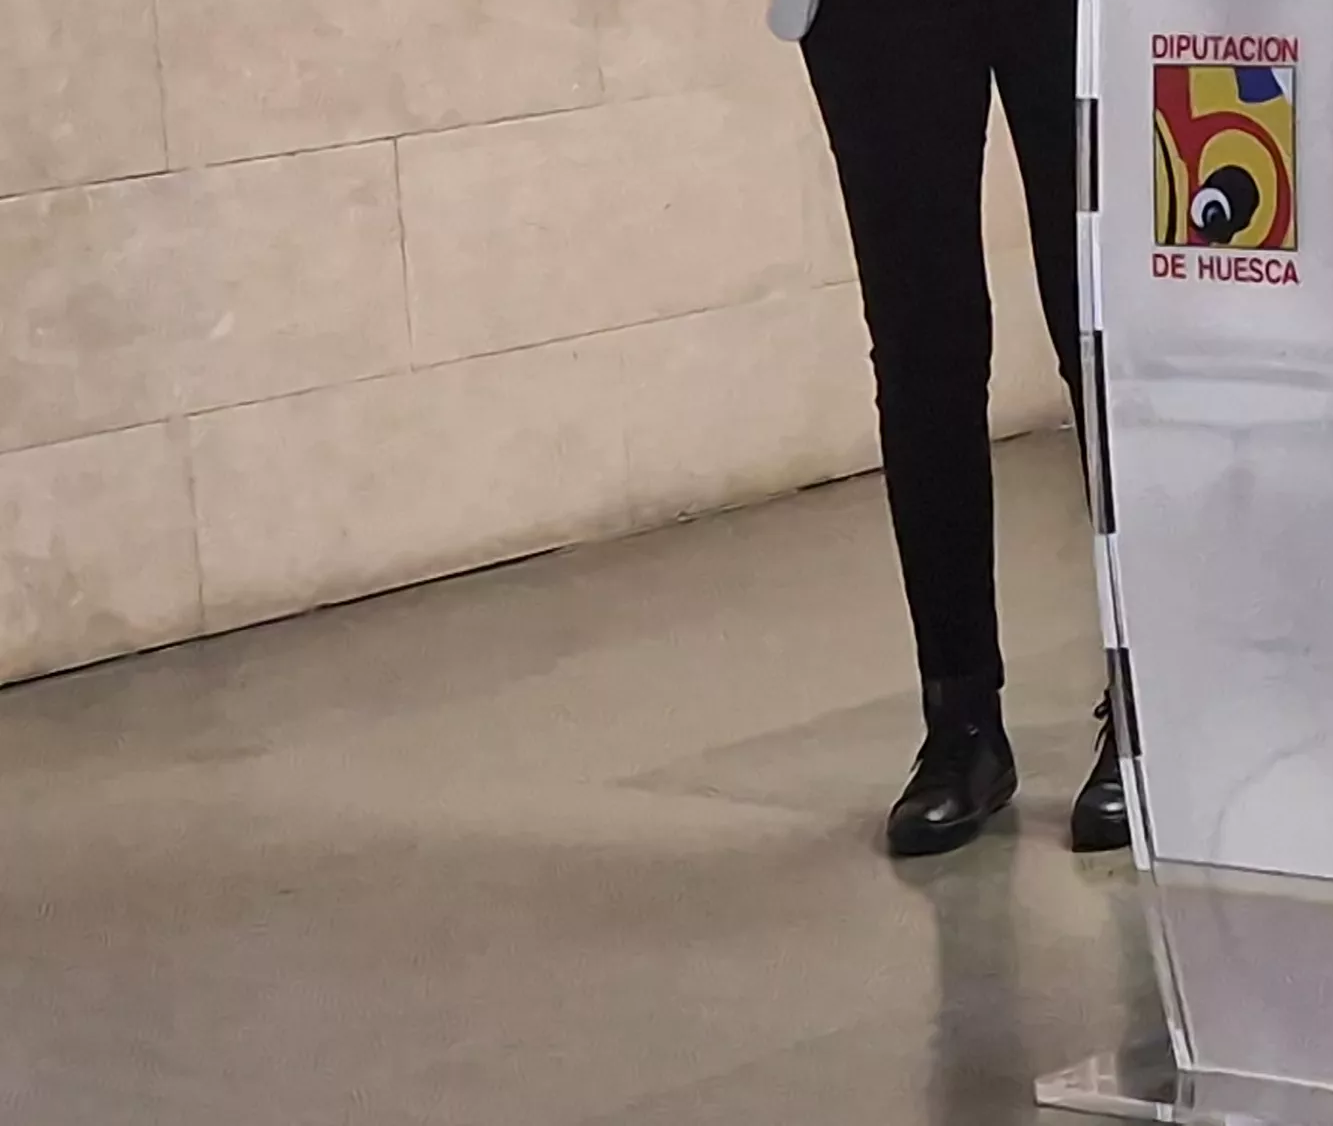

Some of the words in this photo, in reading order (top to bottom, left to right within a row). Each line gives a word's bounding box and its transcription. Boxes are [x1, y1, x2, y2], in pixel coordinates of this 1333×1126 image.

[1151, 33, 1299, 63] DIPUTACION
[1152, 252, 1188, 280] DE
[1197, 254, 1300, 285] HUESCA
